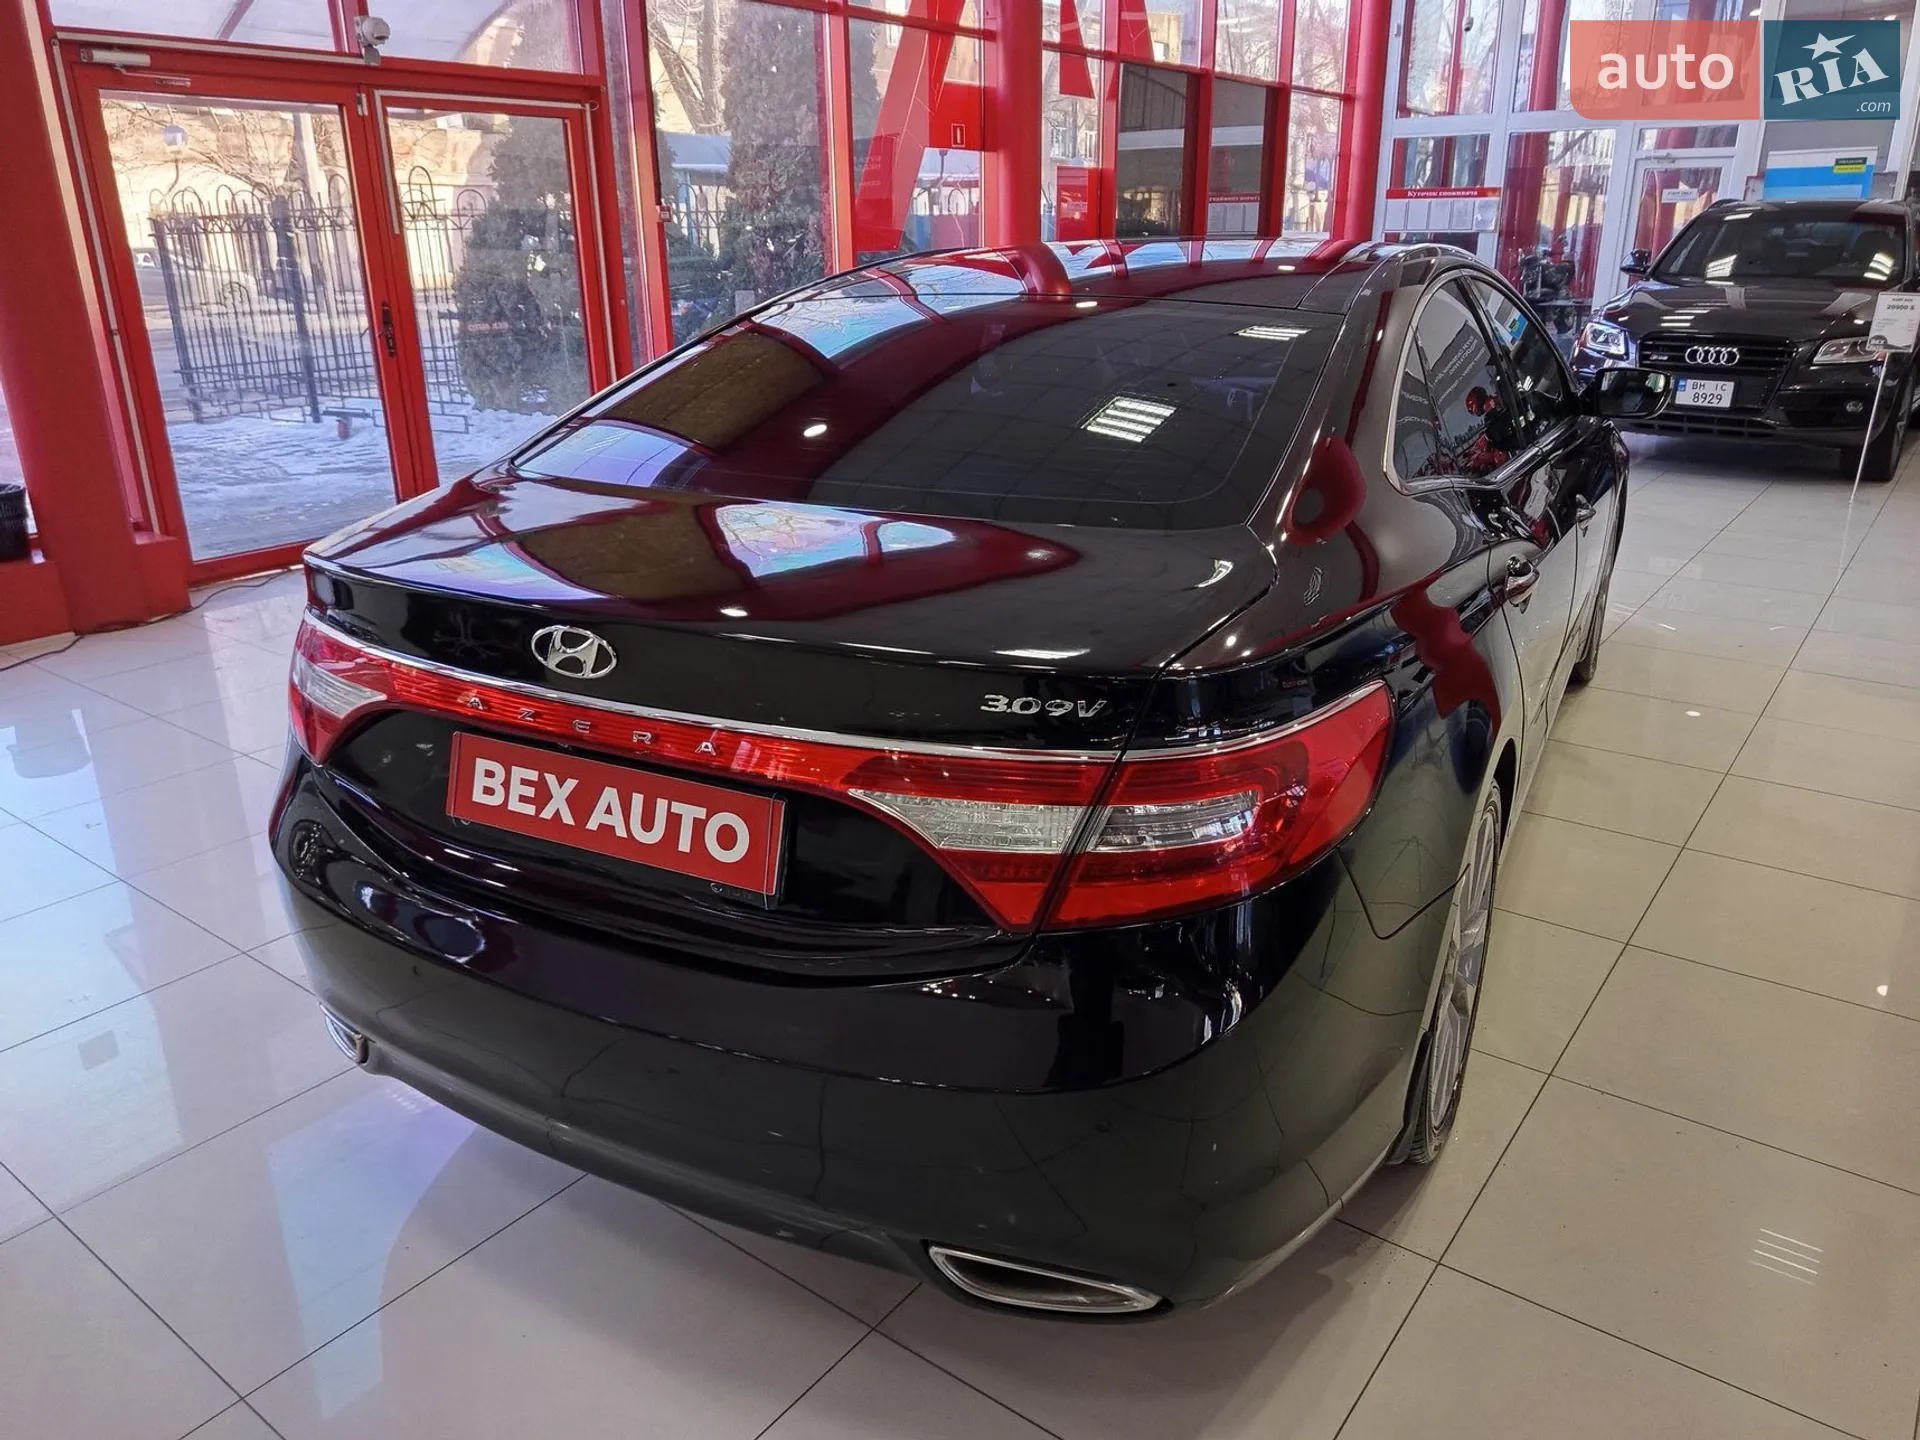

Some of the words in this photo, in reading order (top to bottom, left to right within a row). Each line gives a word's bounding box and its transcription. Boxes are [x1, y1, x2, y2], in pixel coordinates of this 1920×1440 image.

[1691, 381, 1706, 390] BH
[1691, 391, 1723, 405] 8929
[466, 696, 717, 756] AZERA
[471, 757, 579, 826] BEX
[585, 786, 750, 864] AUTO
